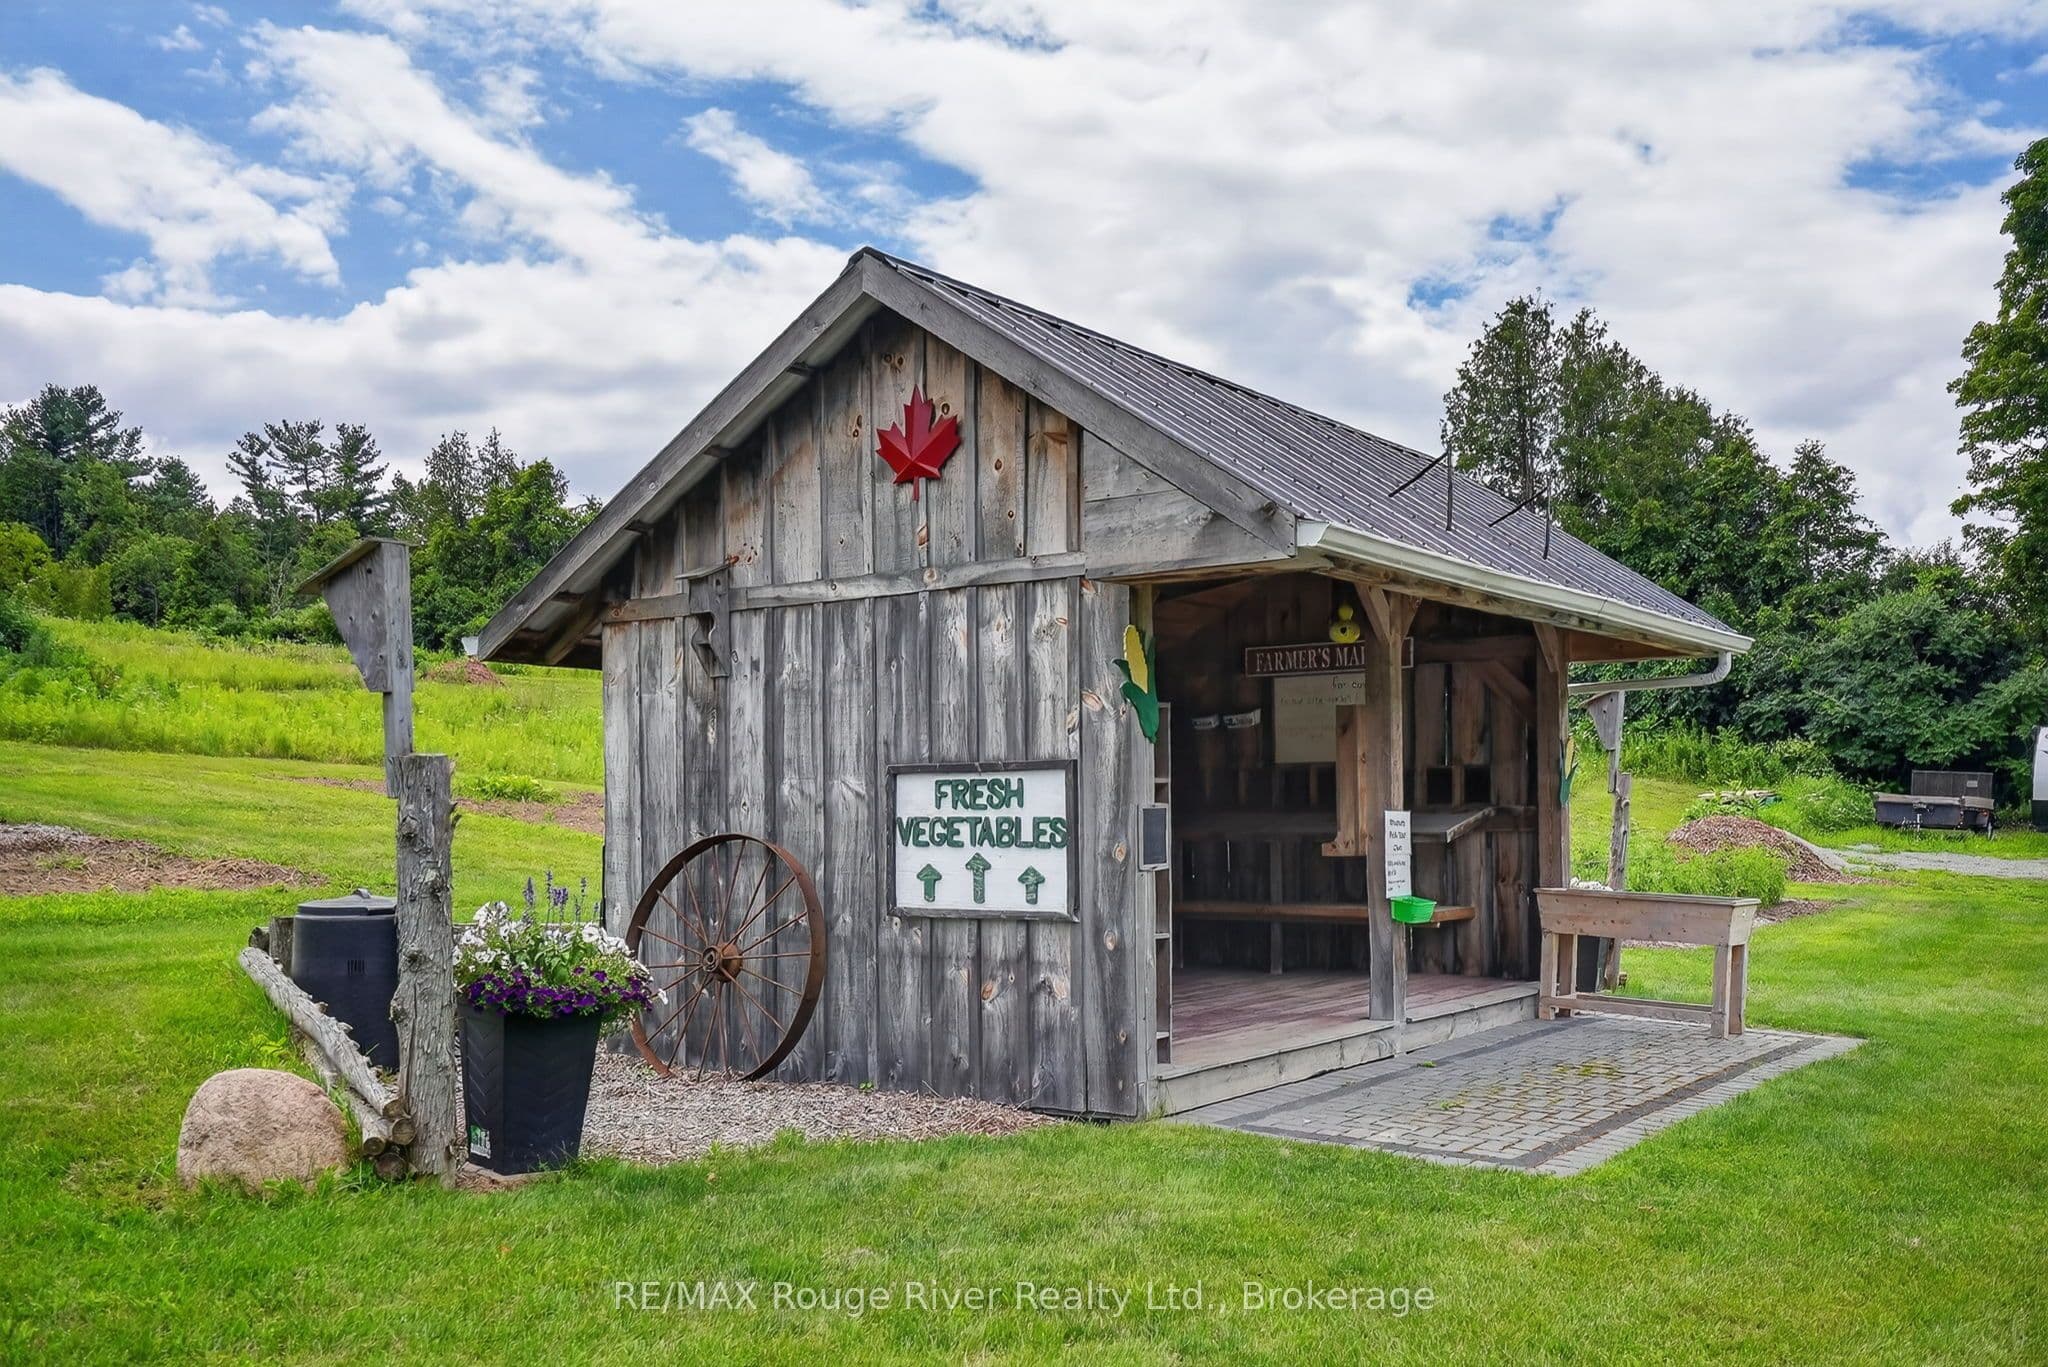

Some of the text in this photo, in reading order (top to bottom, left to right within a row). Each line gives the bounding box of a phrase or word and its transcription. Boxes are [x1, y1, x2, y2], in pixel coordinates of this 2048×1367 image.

[1255, 647, 1331, 672] FARMER'S
[934, 777, 1024, 811] FRESH
[897, 816, 1068, 849] VEGETABLES
